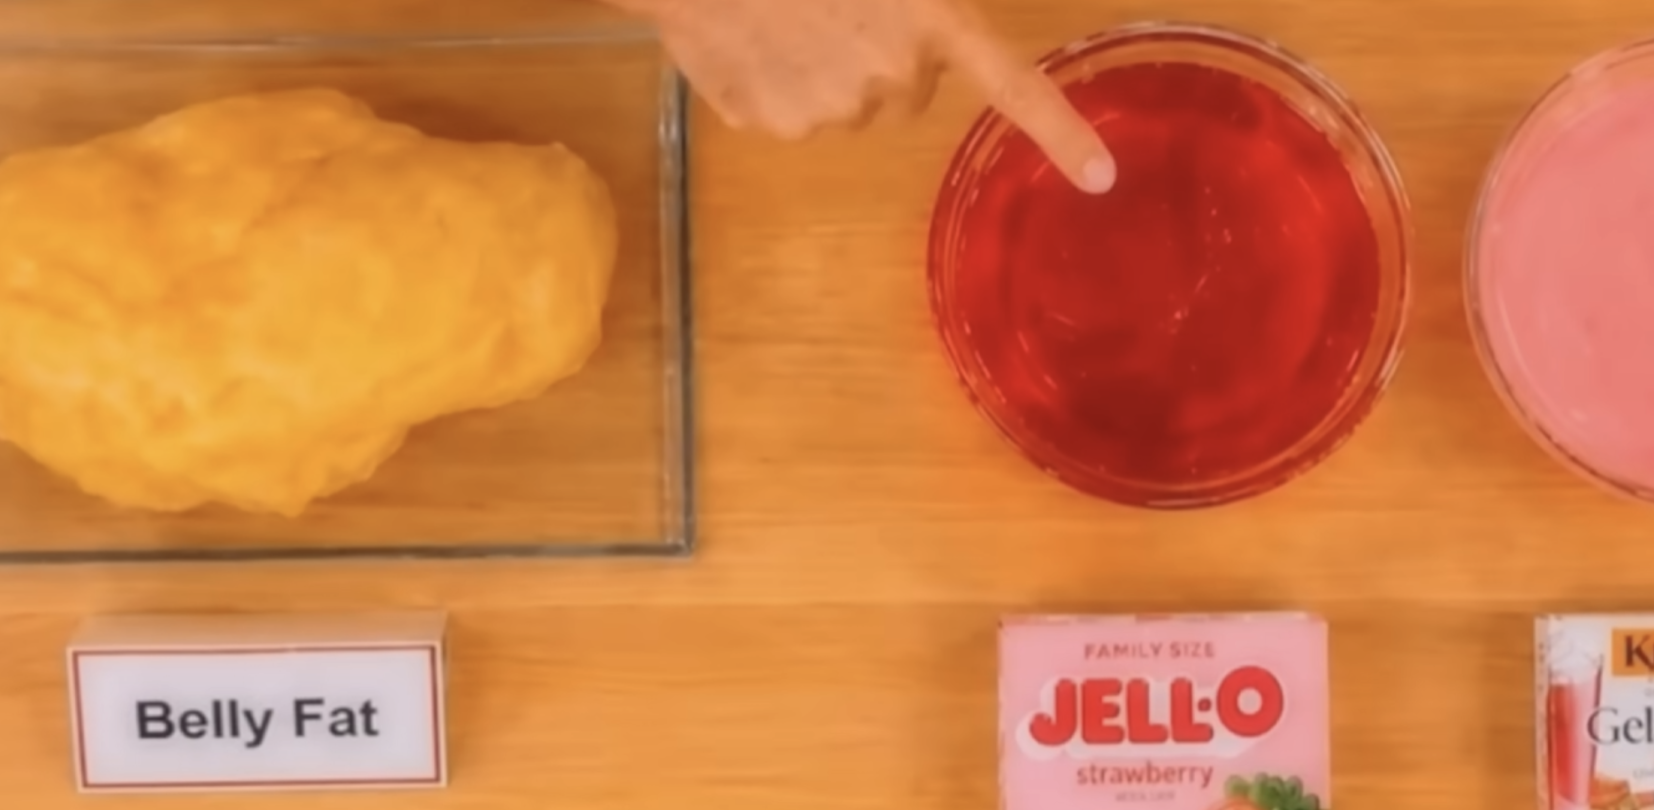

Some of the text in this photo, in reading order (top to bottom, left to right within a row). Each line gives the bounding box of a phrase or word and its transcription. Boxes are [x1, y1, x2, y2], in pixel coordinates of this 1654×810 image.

[1084, 641, 1215, 660] FAMILY SIZE
[136, 697, 380, 749] Belly Fat
[1076, 760, 1214, 789] strawberry
